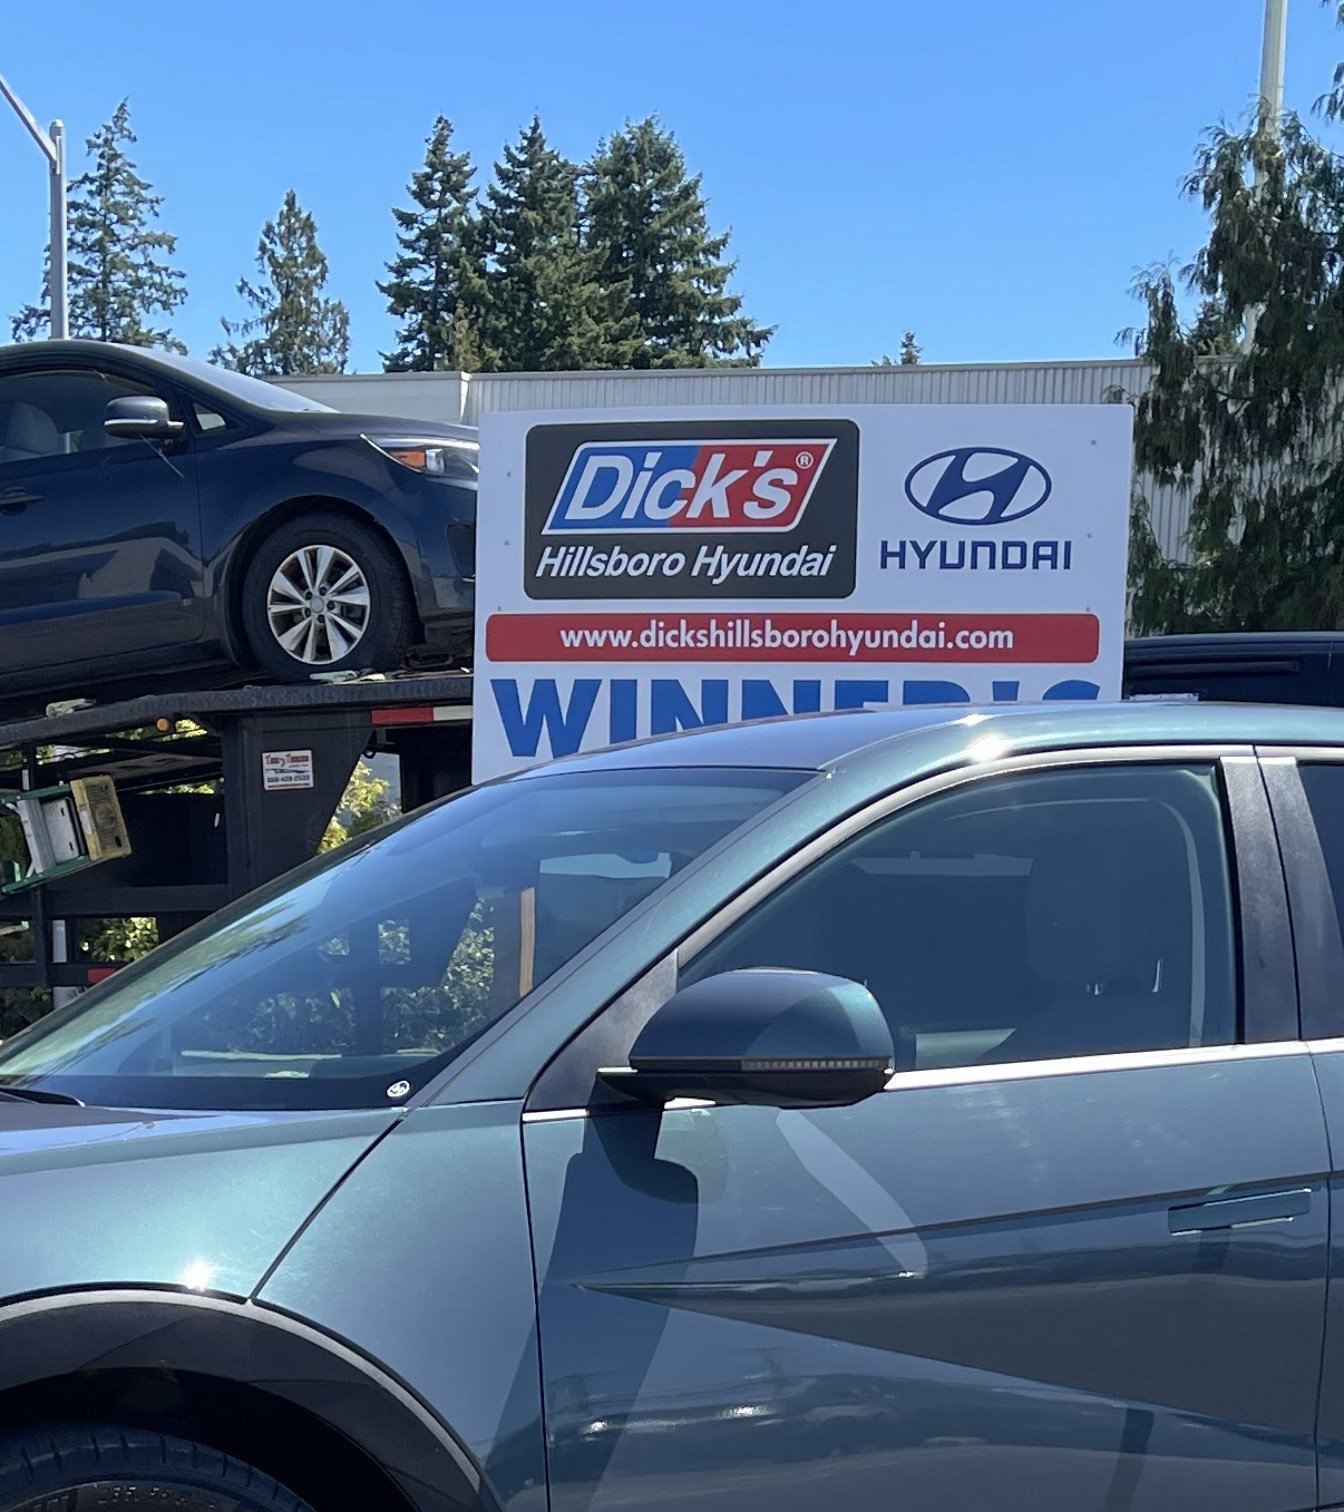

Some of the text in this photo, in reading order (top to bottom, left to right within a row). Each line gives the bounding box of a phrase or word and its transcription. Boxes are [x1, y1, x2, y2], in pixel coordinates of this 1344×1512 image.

[535, 544, 837, 586] Hillsboro Hyundai
[879, 540, 1073, 570] HYUNDAI
[560, 619, 1015, 656] www.dickshillsborohyundai.com
